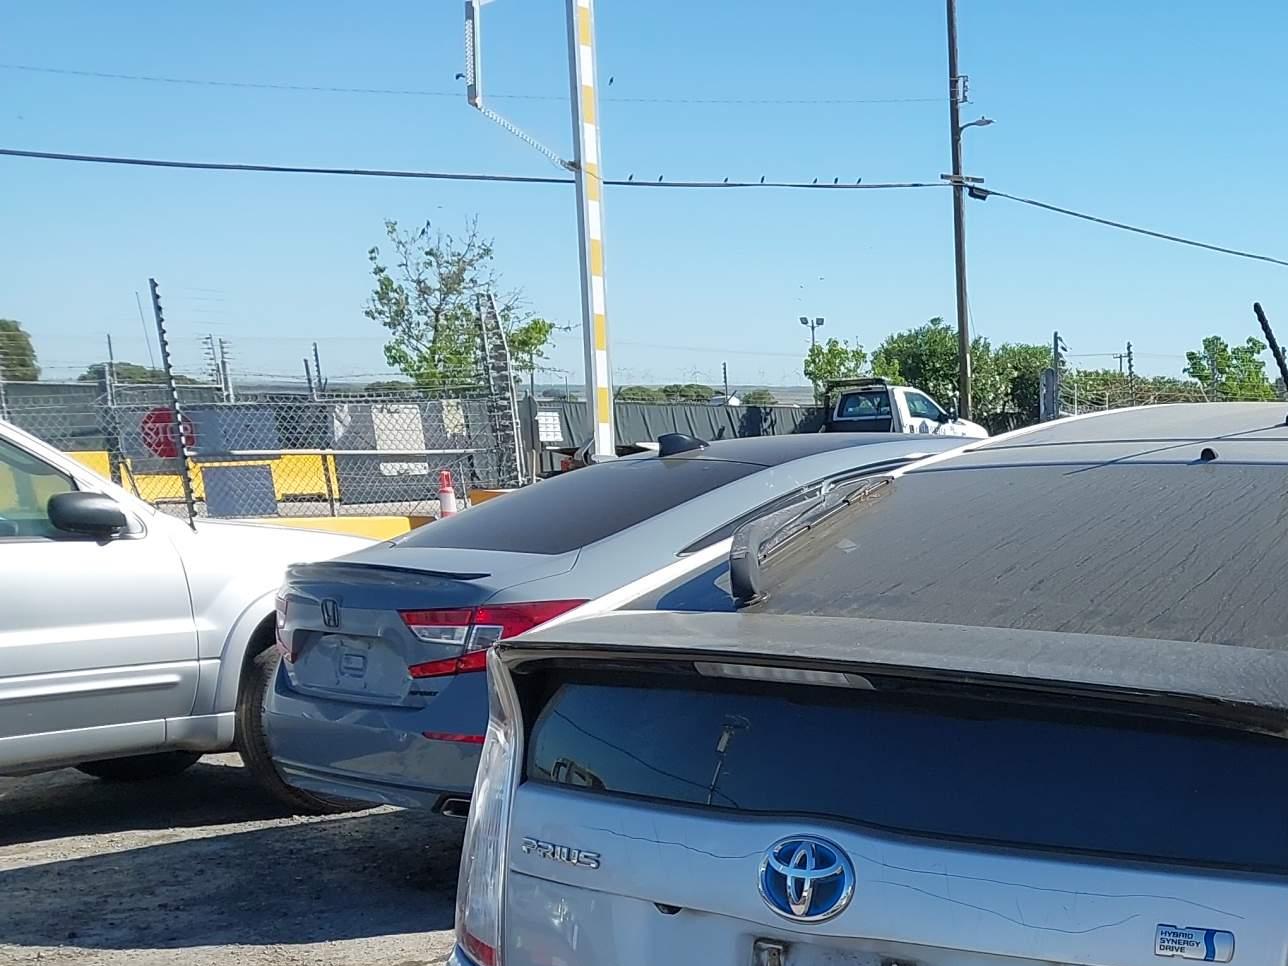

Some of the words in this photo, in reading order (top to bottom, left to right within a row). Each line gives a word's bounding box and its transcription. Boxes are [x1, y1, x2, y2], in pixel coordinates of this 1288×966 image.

[521, 836, 601, 870] PRIUS
[1160, 929, 1194, 940] HYBRID
[1159, 937, 1201, 948] SYNERGY
[1159, 944, 1186, 953] DRIVE
